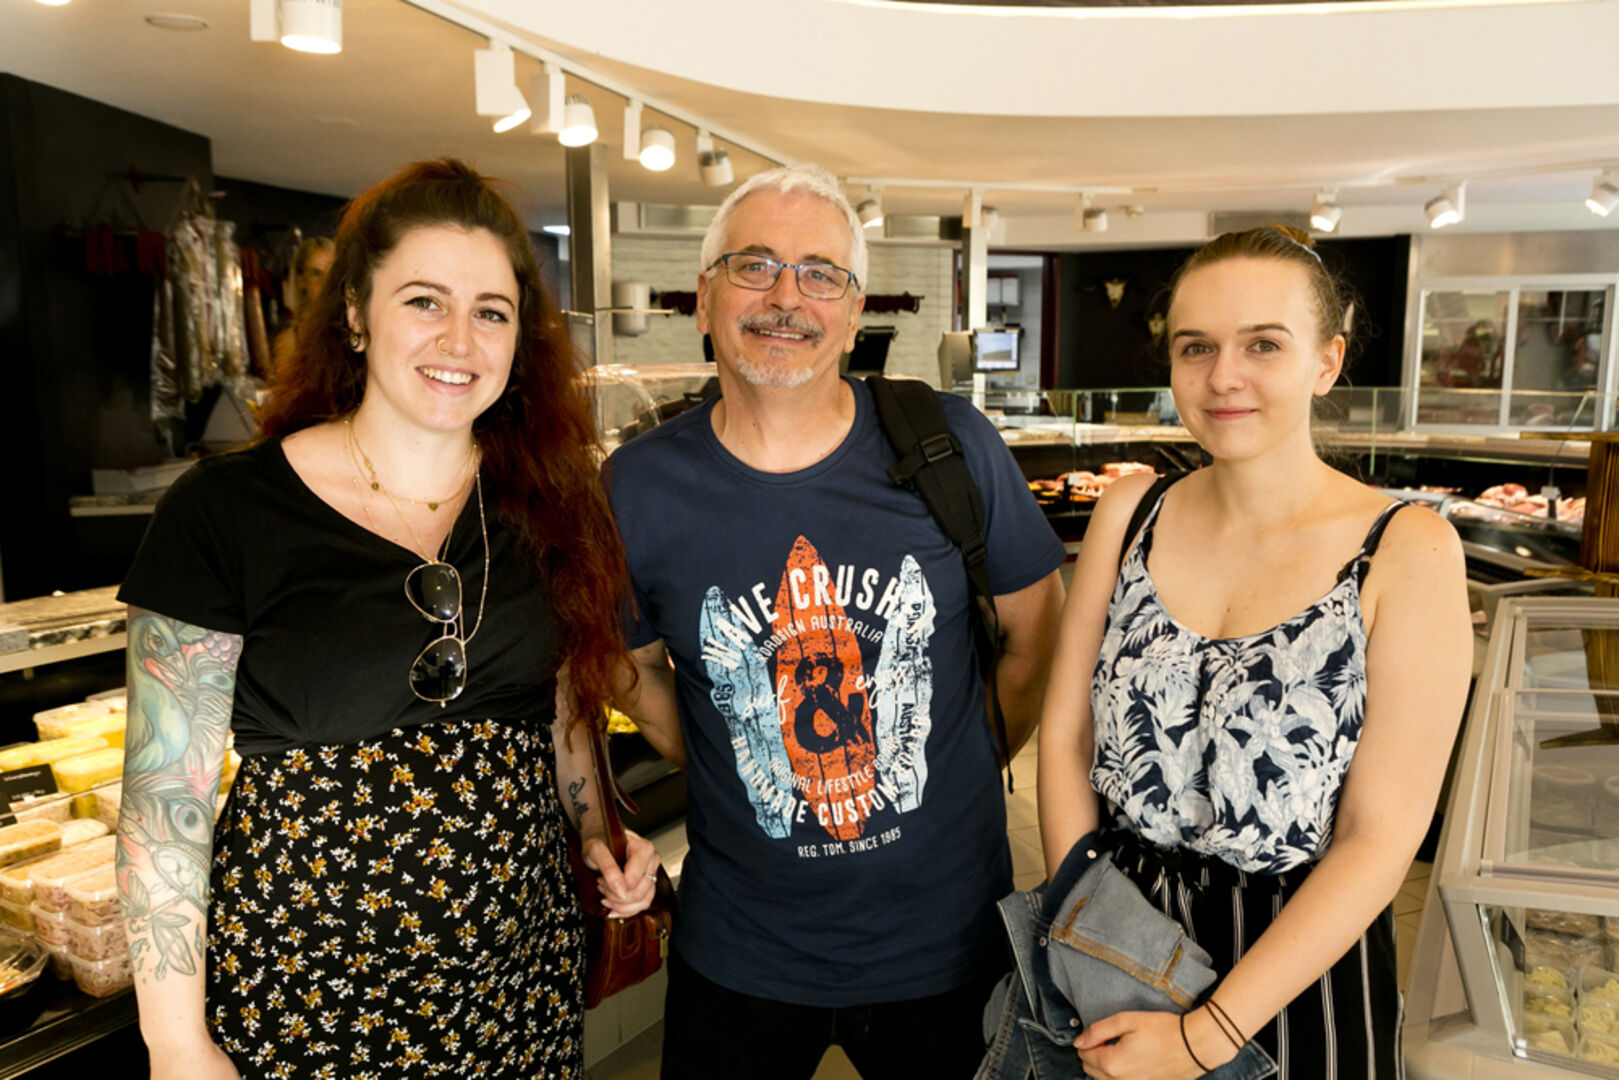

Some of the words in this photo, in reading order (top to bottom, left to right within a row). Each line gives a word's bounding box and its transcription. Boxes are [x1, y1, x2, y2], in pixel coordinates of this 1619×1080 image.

[701, 582, 779, 670] WAVE
[810, 615, 884, 643] AUSTRALIA
[731, 736, 808, 823] HANDMADE
[818, 775, 900, 826] CUSTOM
[817, 764, 874, 795] LIFESTYLE
[798, 845, 820, 859] REG.
[849, 836, 878, 853] SINCE
